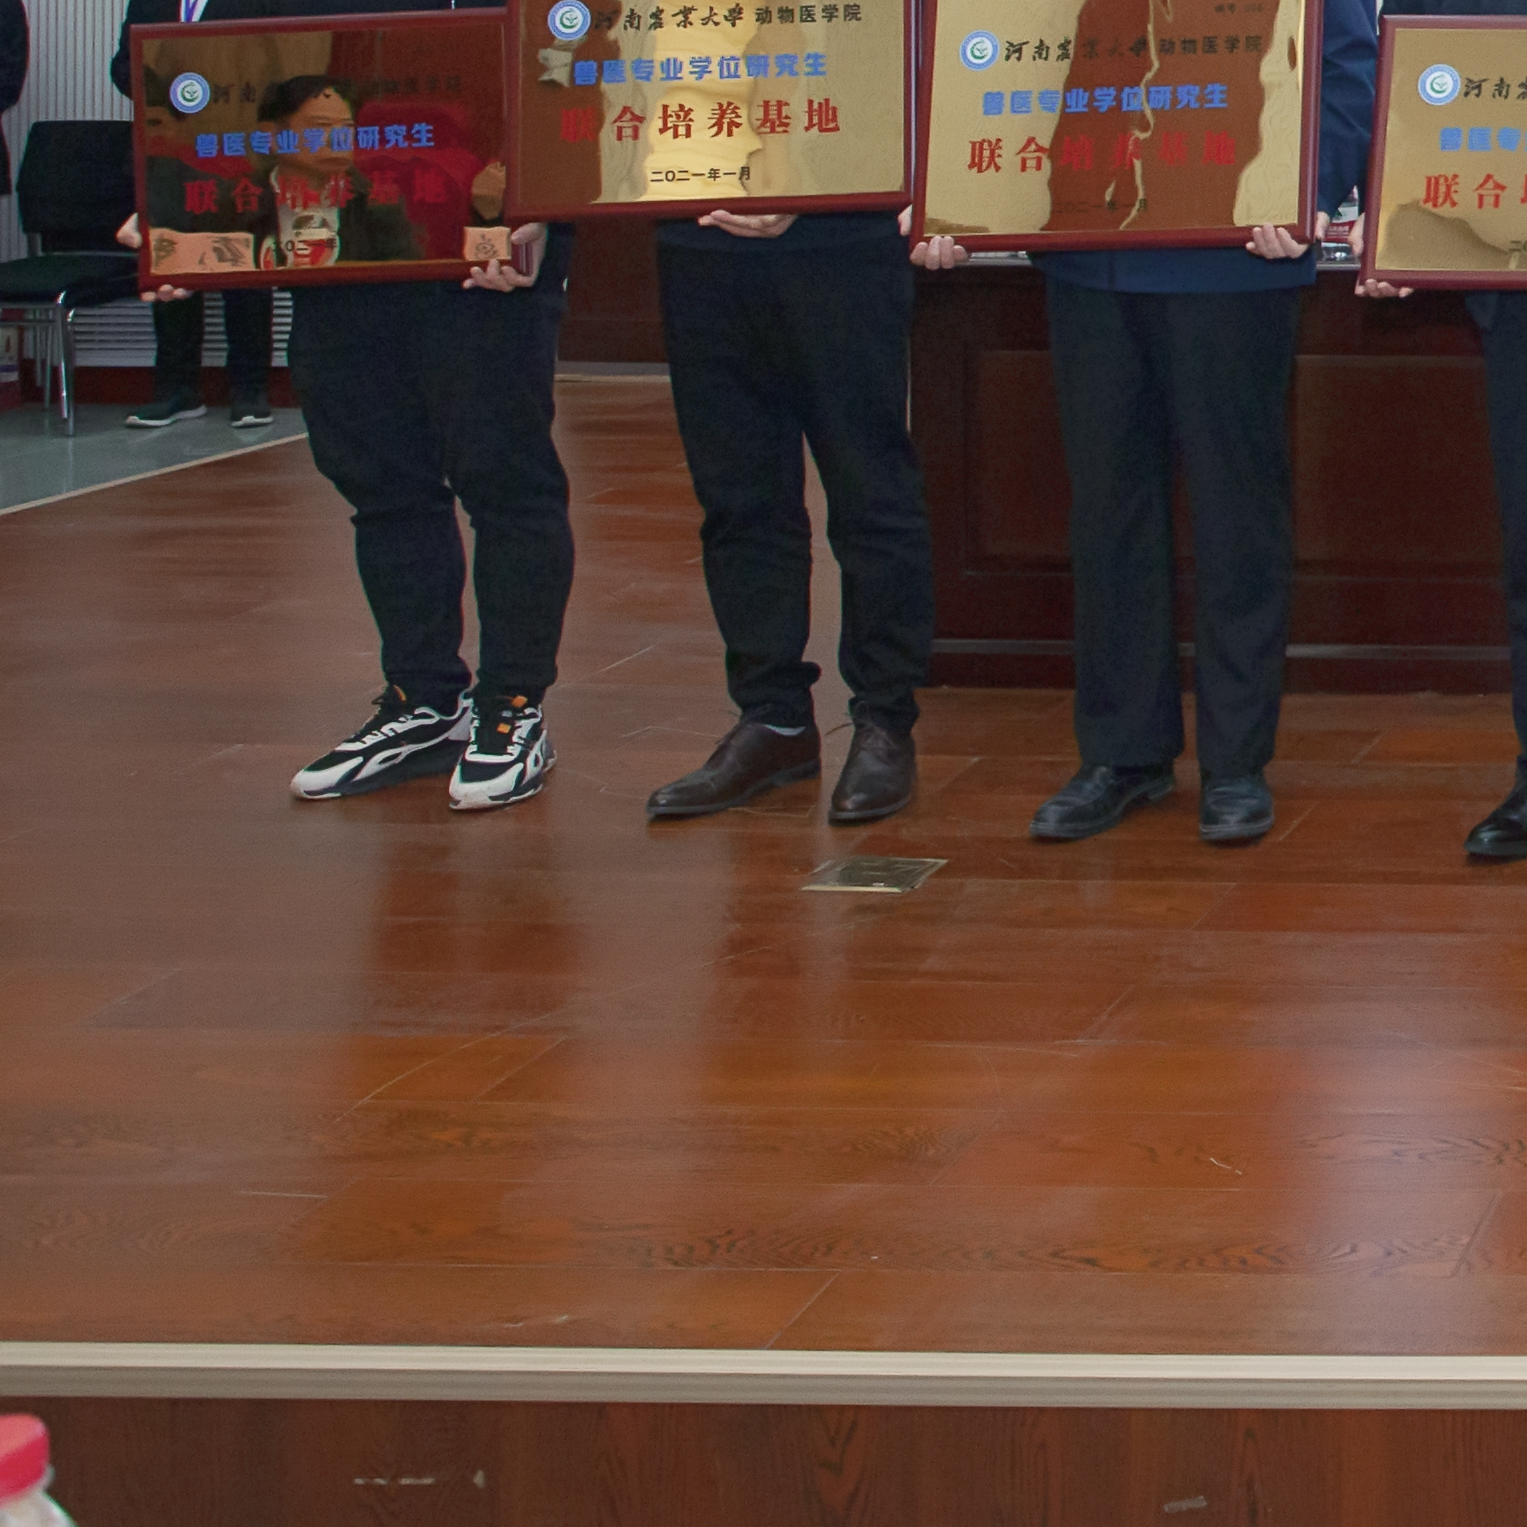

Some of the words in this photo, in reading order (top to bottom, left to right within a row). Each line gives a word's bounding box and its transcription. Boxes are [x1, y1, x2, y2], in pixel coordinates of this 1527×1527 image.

[573, 51, 828, 87] 兽医专业学位研究生
[982, 83, 1229, 116] 兽医专业学位研究生
[559, 98, 841, 143] 联合培养基地
[195, 122, 436, 159] 兽医专业学位研究生
[966, 130, 1237, 174] 联合培养基地
